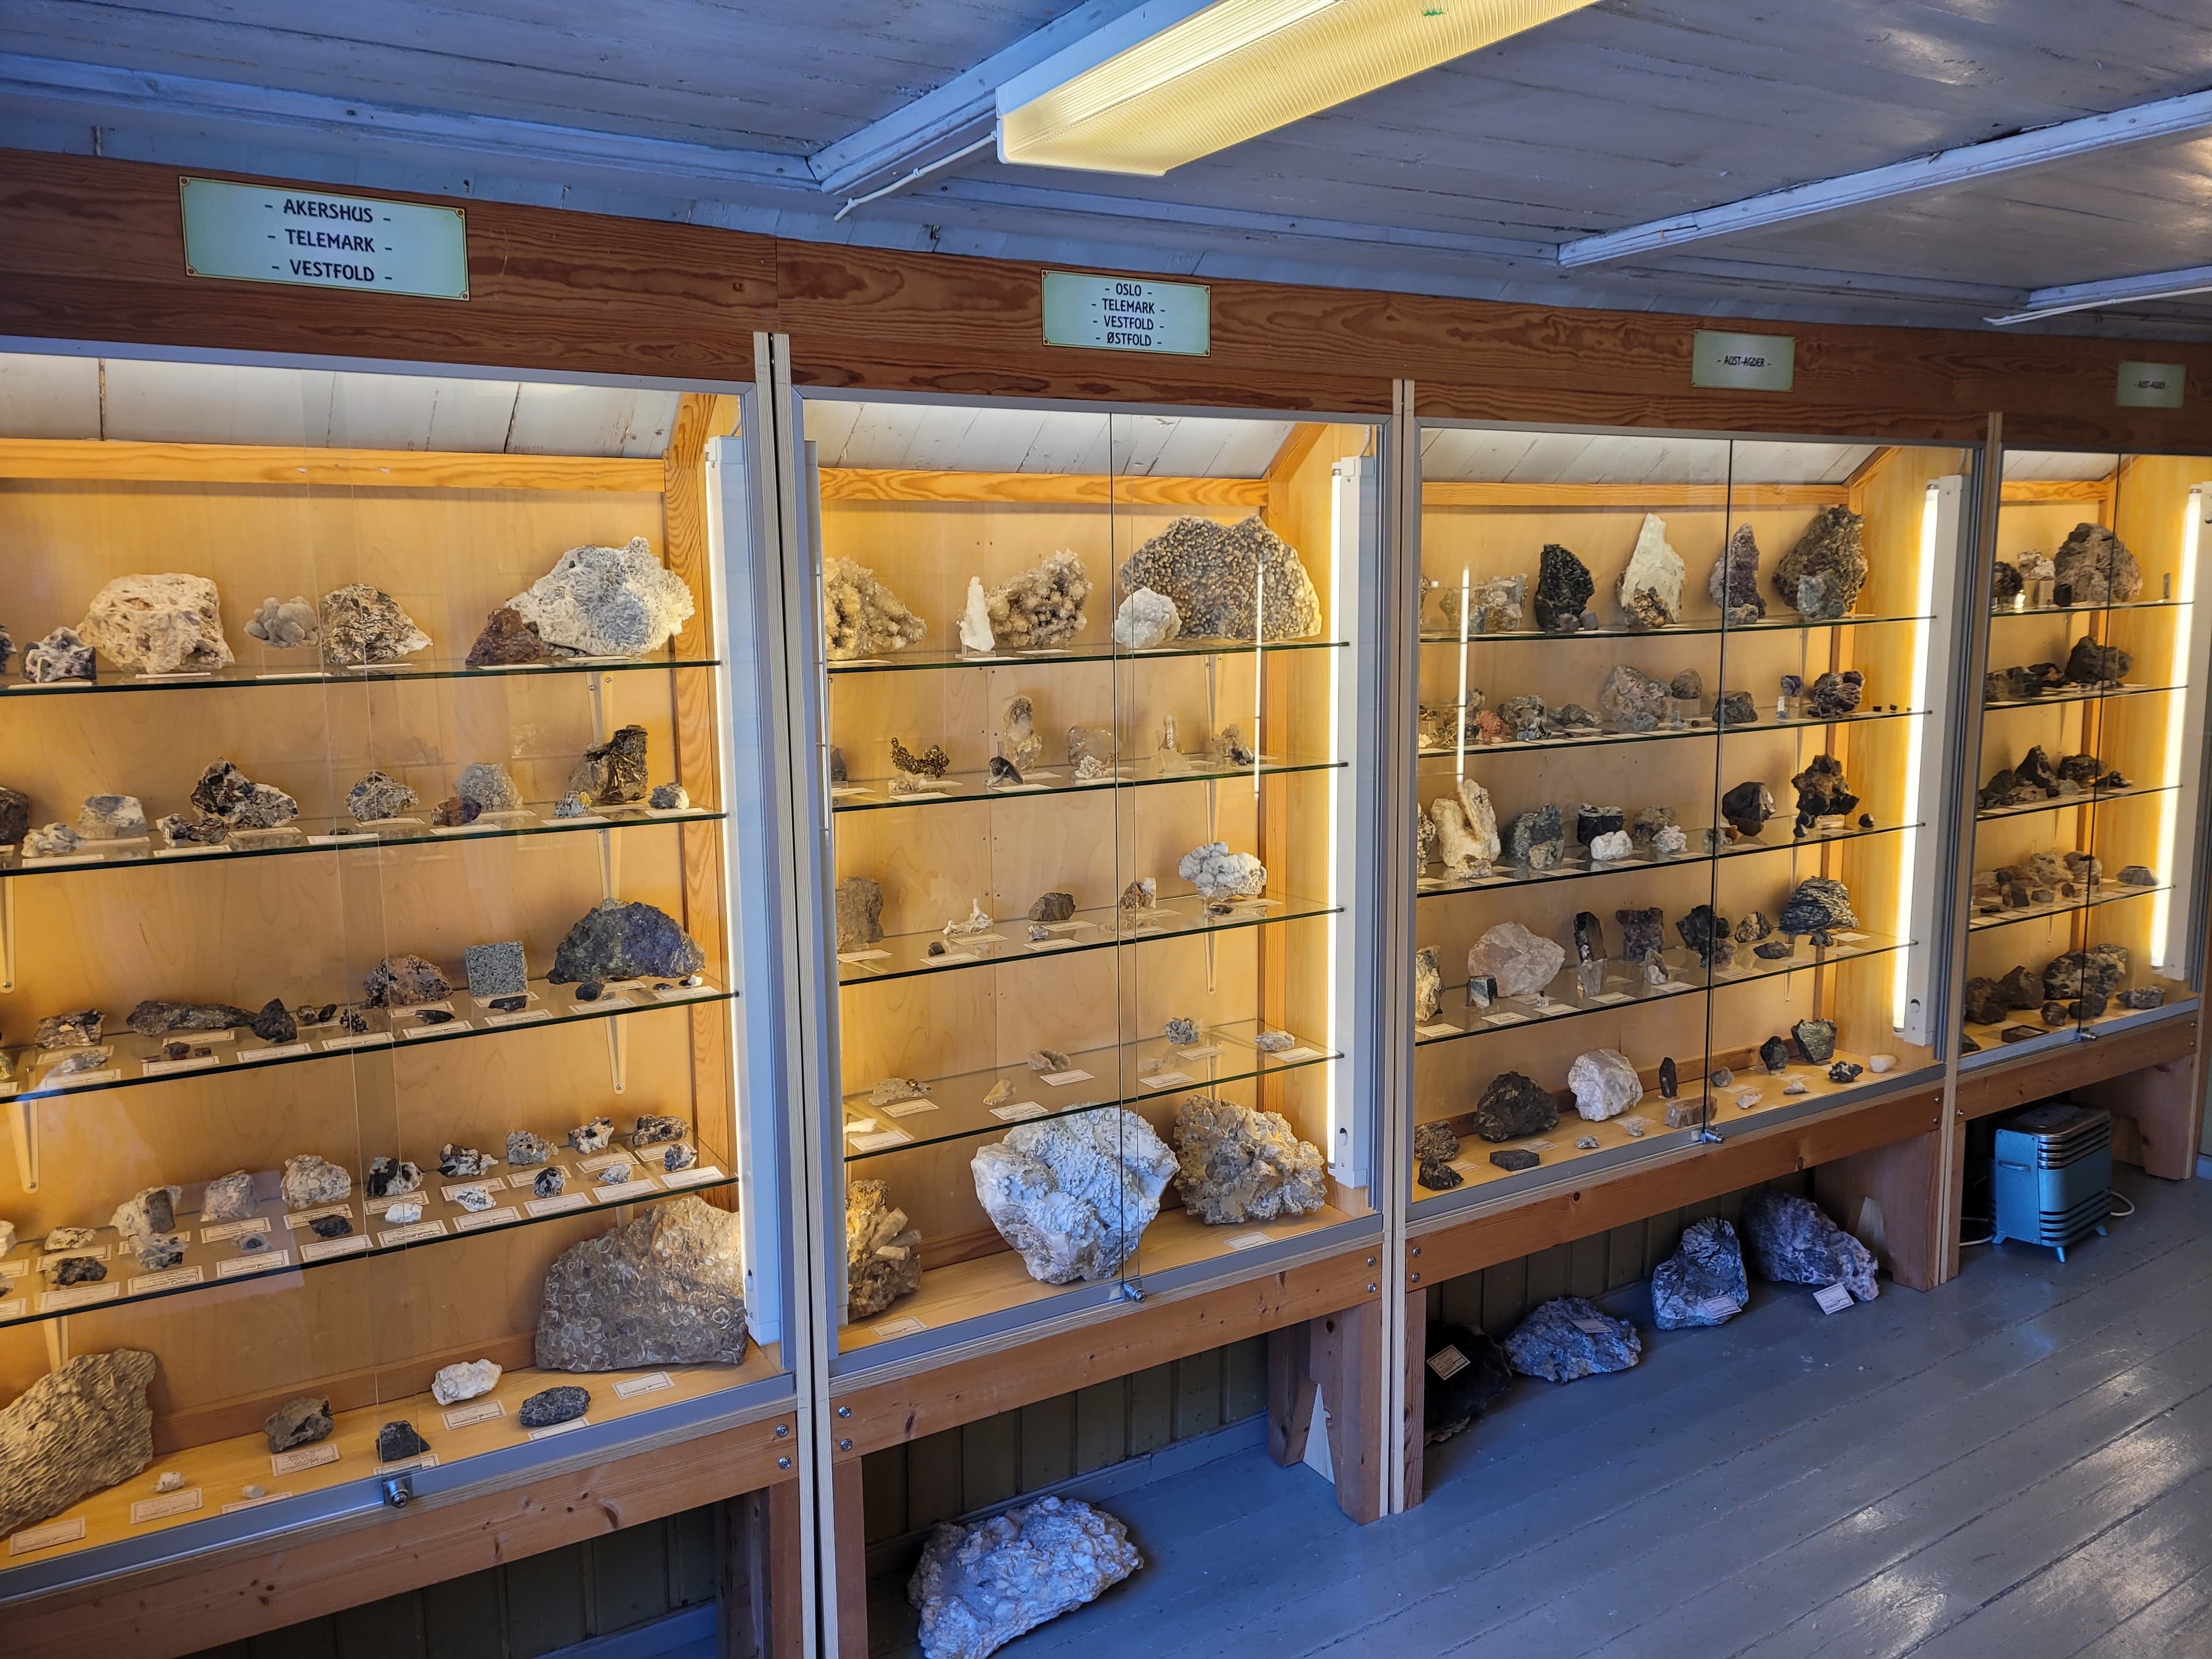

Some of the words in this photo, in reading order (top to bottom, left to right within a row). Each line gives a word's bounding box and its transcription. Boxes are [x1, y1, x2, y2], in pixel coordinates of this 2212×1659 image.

[283, 198, 373, 224] AKERSHUS
[285, 228, 376, 253] TELEMARK
[289, 259, 375, 282] VESTFOLD
[1115, 282, 1142, 297] OSLO
[1101, 298, 1155, 315] TELEMARK
[1103, 315, 1154, 331] VESTFOLD
[1107, 331, 1152, 347] ØSTFOLD
[1724, 355, 1765, 368] AUST-AGDER
